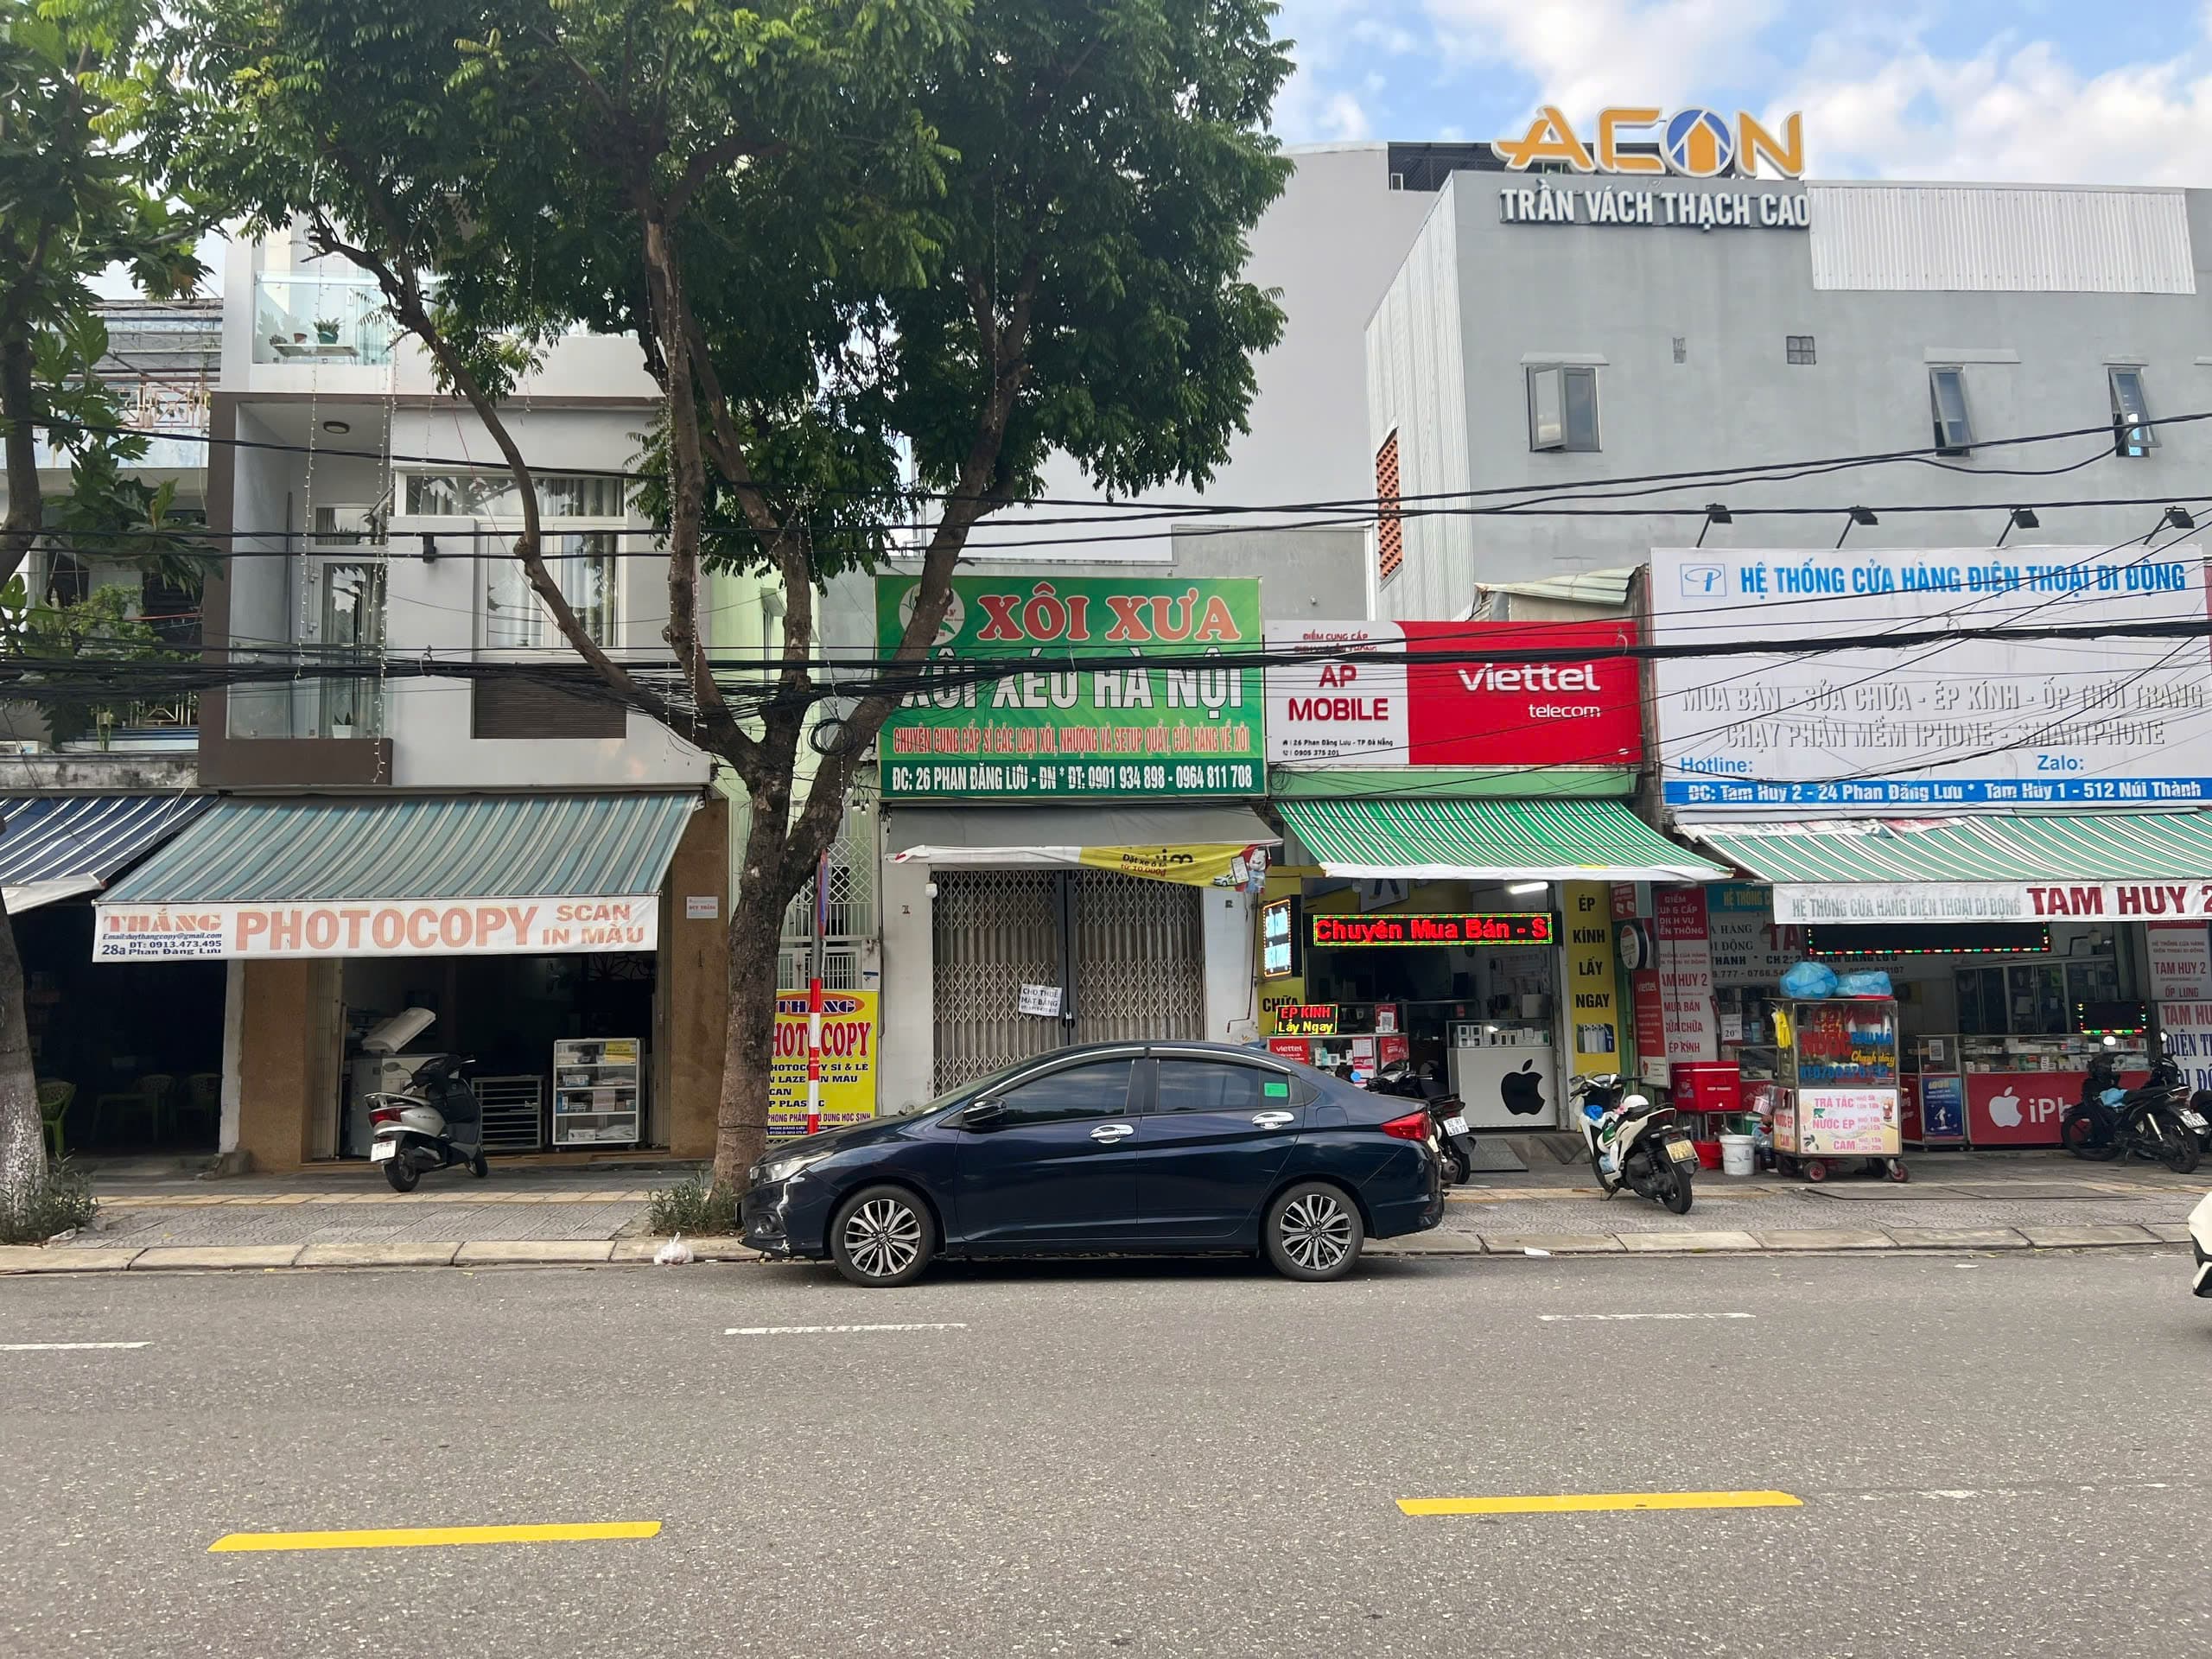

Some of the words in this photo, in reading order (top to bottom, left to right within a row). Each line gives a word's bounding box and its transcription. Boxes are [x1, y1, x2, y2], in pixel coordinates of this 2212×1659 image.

[1492, 105, 1805, 177] ACON
[1500, 178, 1575, 222] TRẦN
[1585, 183, 1654, 224] VÁCH
[1662, 193, 1750, 232] THẠCH
[1759, 194, 1811, 226] CAO
[1740, 562, 1768, 599] HỆ
[1774, 558, 1845, 593] THỐNG
[1852, 558, 1895, 594] CỬA
[1901, 562, 1961, 594] HÀNG
[1967, 561, 2020, 599] ĐIỆN
[2026, 564, 2091, 598] THOẠI
[2096, 563, 2120, 591] DI
[2125, 558, 2186, 597] ĐỘNG
[976, 581, 1090, 641] XÔI
[1105, 587, 1243, 641] XƯA
[1093, 646, 1154, 709] HÀ
[1166, 646, 1243, 719] NỘI
[1319, 664, 1357, 688] AP
[1458, 663, 1601, 692] viettel
[1683, 687, 1731, 712] MUA
[1737, 682, 1782, 711] BÁN
[1805, 678, 1847, 712] SỬA
[1854, 682, 1912, 711] CHỮA
[1933, 681, 1960, 710] ÉP
[1967, 680, 2019, 710] KÍNH
[2042, 677, 2070, 709] ỐP
[2135, 683, 2205, 709] TRANG
[1288, 697, 1389, 721] MOBILE
[1528, 703, 1601, 718] telecom
[893, 722, 931, 753] CHUYÊN
[934, 727, 959, 753] CUNG
[962, 719, 982, 753] CẤP
[995, 722, 1014, 753] CÁC
[1016, 727, 1037, 760] LOẠI
[1059, 725, 1098, 759] NHƯỢNG
[1100, 721, 1113, 753] VÀ
[1115, 727, 1143, 753] SETUP
[1173, 719, 1192, 753] CỬA
[1193, 721, 1219, 753] HÀNG
[1234, 721, 1250, 752] XÔI
[1727, 724, 1780, 753] CHẠY
[1789, 715, 1847, 748] PHẦN
[1853, 716, 1907, 748] MỀM
[1916, 722, 1994, 748] IPHONE
[2018, 721, 2165, 748] SMARTPHONE
[1681, 757, 1753, 773] Hotline:
[2037, 754, 2084, 771] Zalo:
[893, 766, 912, 791] ĐC:
[916, 766, 931, 791] 26
[934, 766, 967, 791] PHAN
[969, 761, 1002, 791] ĐĂNG
[1006, 763, 1028, 790] LƯU
[1039, 766, 1057, 790] ĐN
[1068, 766, 1085, 790] ĐT:
[1088, 766, 1116, 789] 0901
[1119, 766, 1141, 789] 934
[1144, 766, 1165, 789] 898
[1175, 766, 1205, 789] 0964
[1206, 766, 1228, 788] 811
[1230, 765, 1252, 788] 708
[1688, 786, 1716, 801] ĐC:
[1720, 785, 1752, 801] Tam
[1758, 785, 1788, 803] Huy
[1792, 785, 1802, 800] 2
[1818, 785, 1838, 799] 24
[1842, 785, 1884, 800] Phan
[1888, 784, 1929, 803] Đăng
[1933, 785, 1962, 799] Lưu
[1984, 784, 2018, 799] Tam
[2022, 783, 2052, 800] Huy
[2057, 784, 2066, 798] 1
[2083, 783, 2114, 798] 512
[2120, 781, 2147, 798] Núi
[2152, 781, 2202, 798] Thành
[1578, 894, 1596, 912] ÉP
[2026, 887, 2105, 916] TAM
[2117, 886, 2188, 916] HUY
[104, 908, 222, 932] THẮNG
[556, 904, 631, 923] SCAN
[236, 906, 539, 951] PHOTOCOPY
[543, 929, 570, 945] IN
[581, 923, 645, 944] MÀU
[1316, 919, 1403, 942] Chuyên
[1411, 918, 1459, 939] Mua
[1465, 918, 1510, 938] Bán
[1532, 918, 1547, 938] S
[1573, 926, 1605, 944] KÍNH
[1674, 925, 1704, 934] THÔNG
[1721, 923, 1752, 934] HÀNG
[102, 944, 125, 956] 28a
[1722, 939, 1753, 953] ĐỘNG
[1579, 957, 1603, 976] LẤY
[2154, 962, 2176, 975] TAM
[2178, 962, 2196, 974] HUY
[2199, 961, 2206, 974] 2
[1678, 973, 1698, 987] HUY
[1701, 973, 1707, 986] 2
[1575, 994, 1610, 1008] NGAY
[1664, 1002, 1681, 1012] MUA
[1683, 1000, 1700, 1012] BÁN
[2163, 1005, 2192, 1025] TAM
[1278, 1018, 1300, 1034] Lấy
[1302, 1020, 1333, 1034] Ngay
[1681, 1020, 1703, 1032] CHỮA
[772, 1021, 872, 1058] HOTCOPY
[1669, 1040, 1679, 1052] ÉP
[1814, 1096, 1833, 1108] TRÀ
[1813, 1116, 1840, 1129] NƯỚC
[1842, 1116, 1855, 1129] ÉP
[1834, 1140, 1855, 1150] CAM
